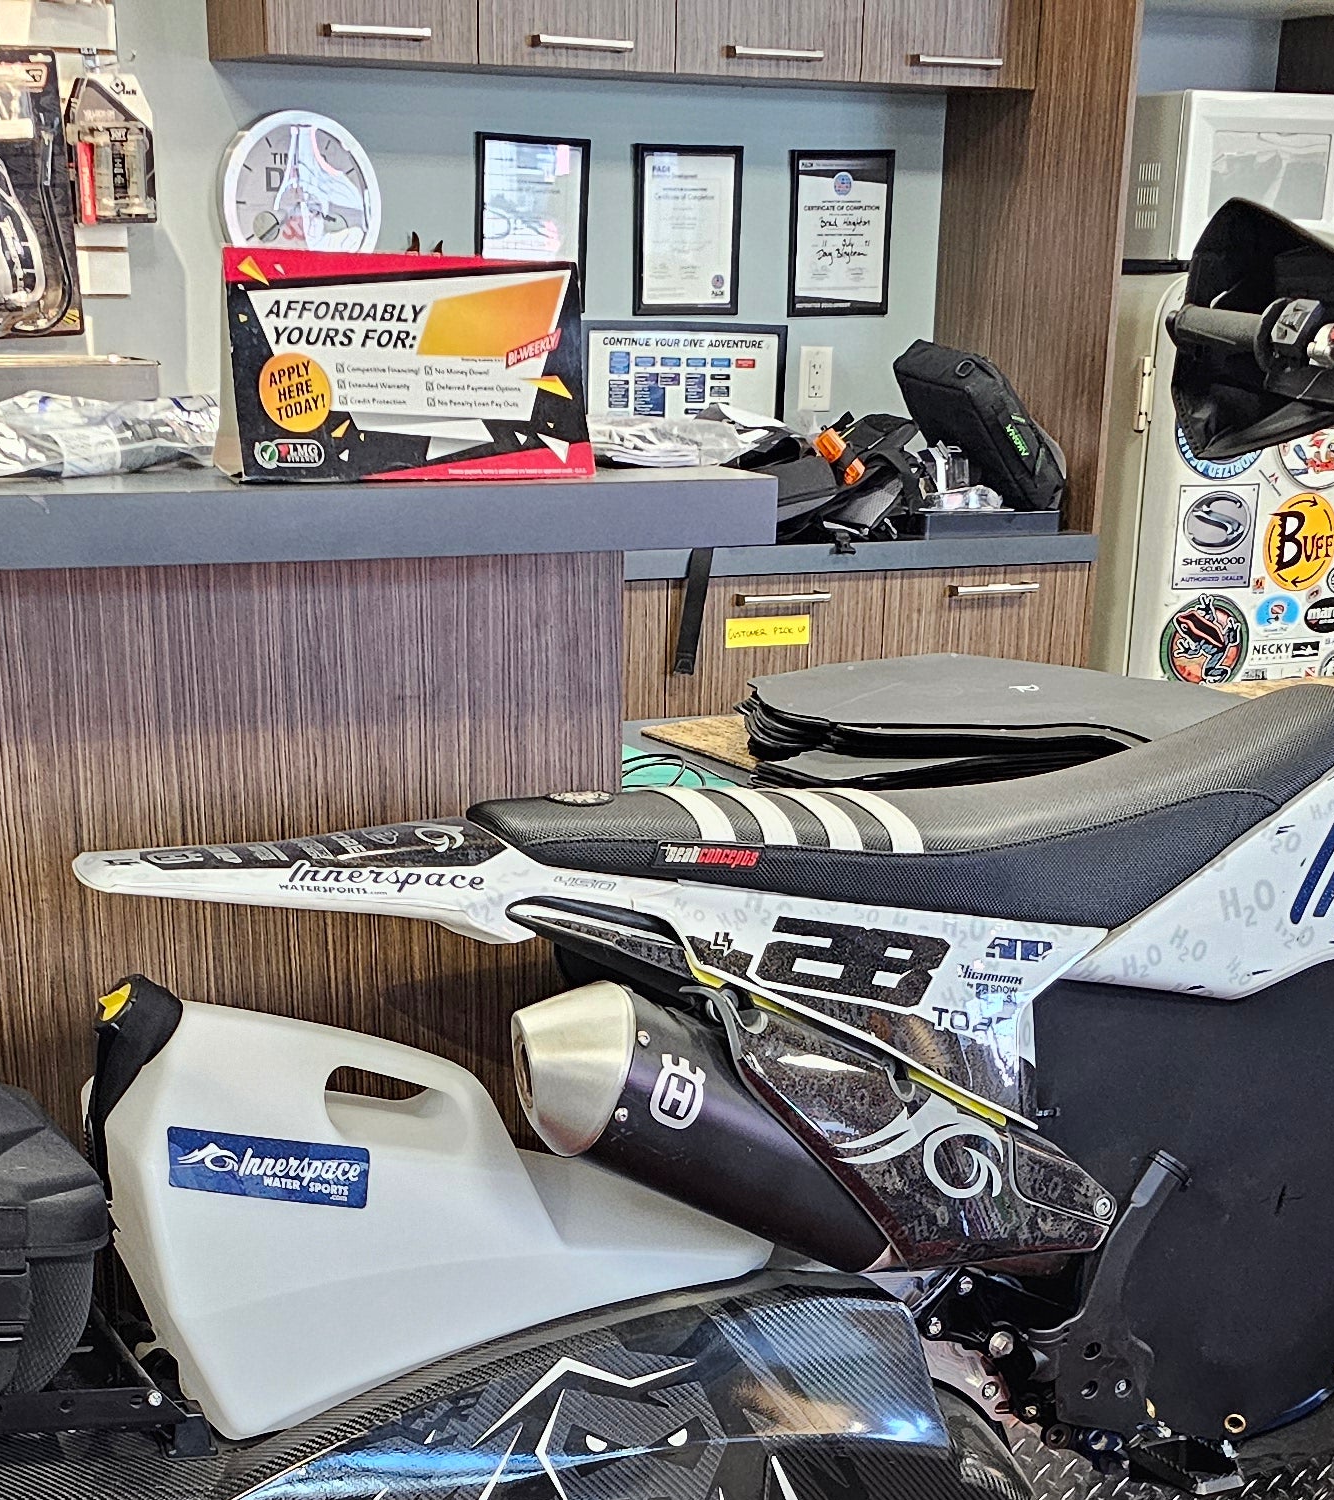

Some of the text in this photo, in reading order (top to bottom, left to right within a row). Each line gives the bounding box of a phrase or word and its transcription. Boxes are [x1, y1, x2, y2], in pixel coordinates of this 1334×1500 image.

[265, 299, 427, 323] AFFORDABLY
[273, 326, 417, 350] YOURS FOR:
[602, 336, 765, 349] CONTINUE YOUR DIVE ADVENTURE
[269, 360, 312, 388] APPLY
[446, 368, 468, 377] Money
[277, 378, 314, 403] HERE
[348, 380, 410, 391] Extended Warranty
[436, 384, 521, 393] Deferred Payment Options
[276, 393, 326, 422] TODAY!
[349, 397, 370, 405] Credit
[1181, 557, 1246, 567] SHERWOOD
[1199, 565, 1228, 573] SCUBA
[1180, 575, 1220, 583] AUTHORIZED
[773, 626, 794, 635] PICK
[1251, 643, 1292, 655] NECKY
[287, 860, 486, 893] Innerspace
[755, 915, 951, 1008] 28
[238, 1147, 362, 1186] Innerspace
[262, 1175, 350, 1196] WATER SPORTS
